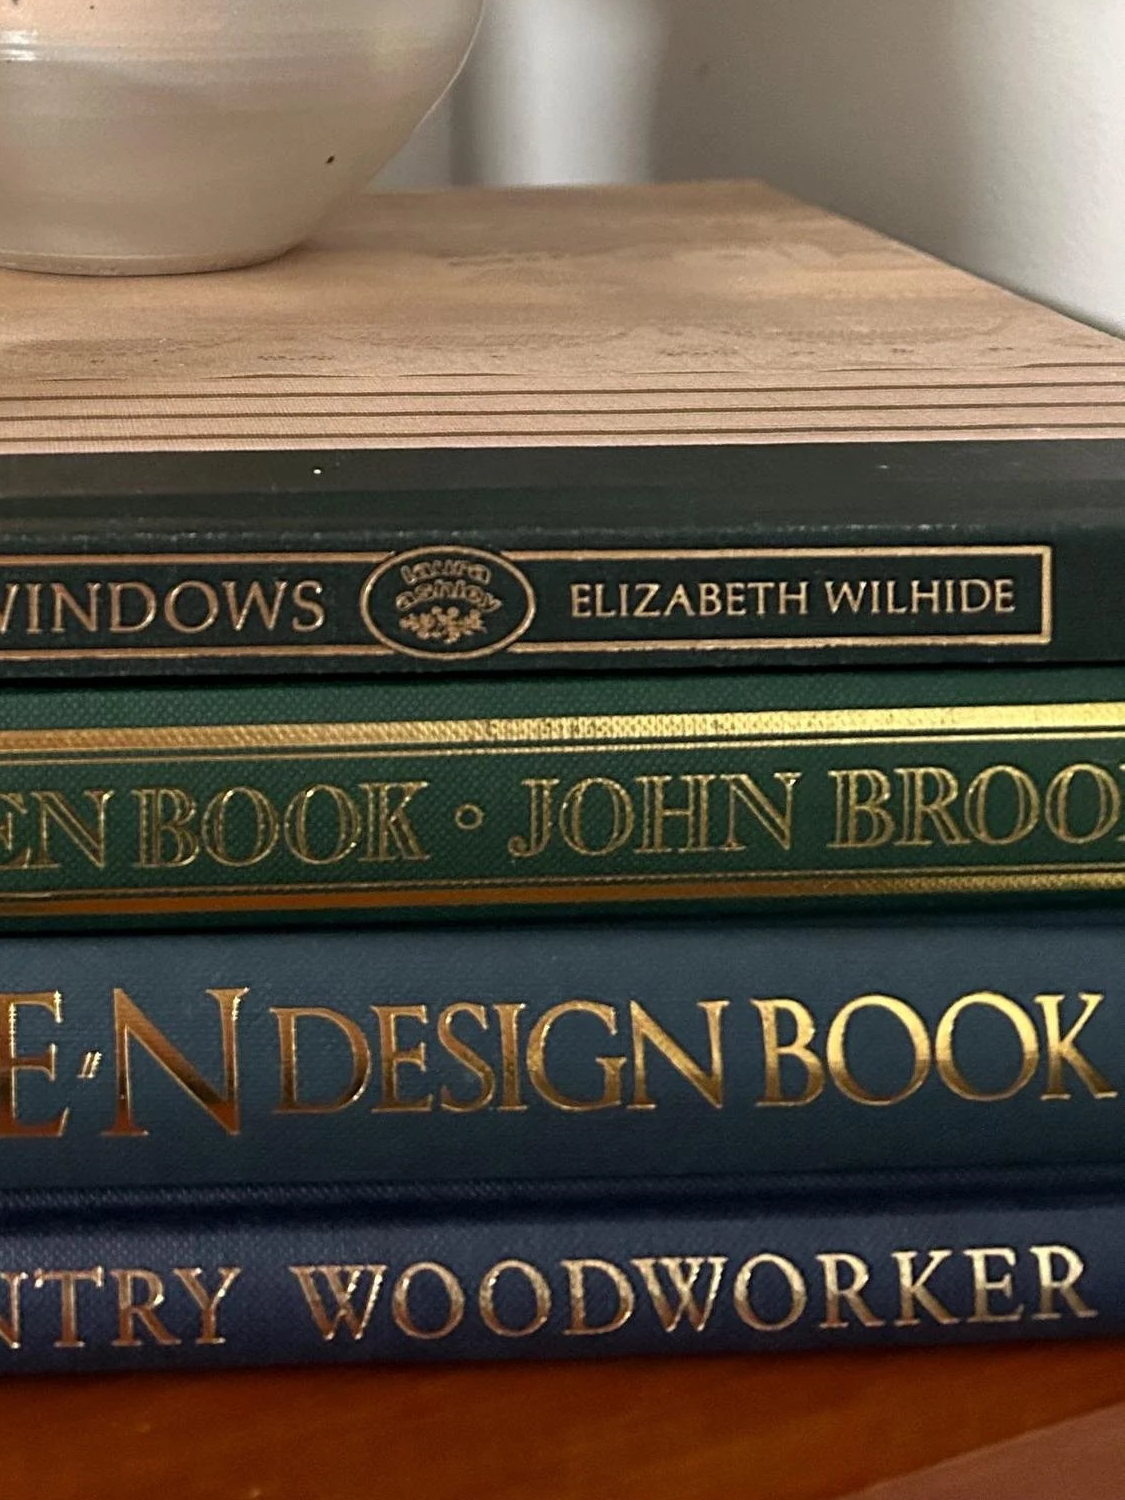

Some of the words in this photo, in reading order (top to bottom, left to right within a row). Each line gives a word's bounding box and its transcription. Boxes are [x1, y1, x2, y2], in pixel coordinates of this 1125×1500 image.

[570, 581, 808, 618] ELIZABETH
[824, 577, 1017, 615] WILHIDE
[132, 780, 431, 868] BOOK
[508, 770, 802, 858] JOHN
[827, 762, 1125, 849] BROO
[268, 999, 730, 1113] DESIGN
[751, 990, 1118, 1108] BOOK
[288, 1244, 1099, 1341] WOODWORKER
